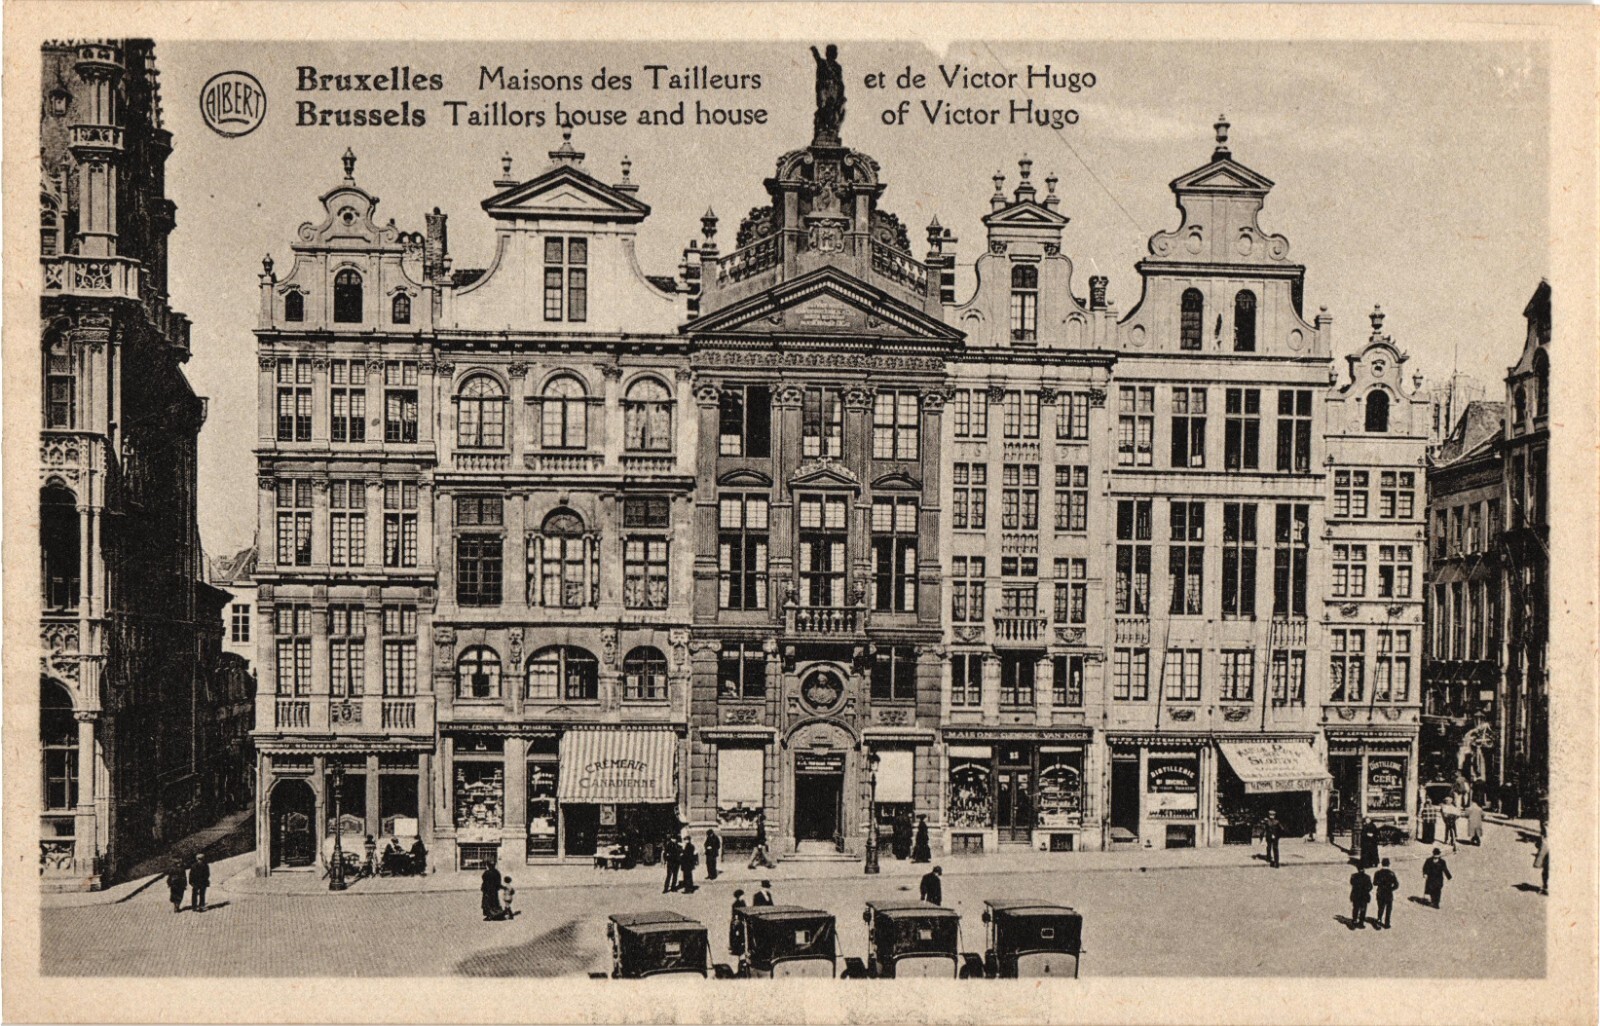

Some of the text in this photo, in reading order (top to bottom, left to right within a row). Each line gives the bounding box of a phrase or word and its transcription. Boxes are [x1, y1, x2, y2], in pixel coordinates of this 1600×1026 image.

[947, 731, 993, 739] MAISON
[1369, 760, 1402, 771] DISTILLERIE
[1150, 766, 1196, 779] DISTILLERIE
[579, 778, 655, 788] CANADIENNE
